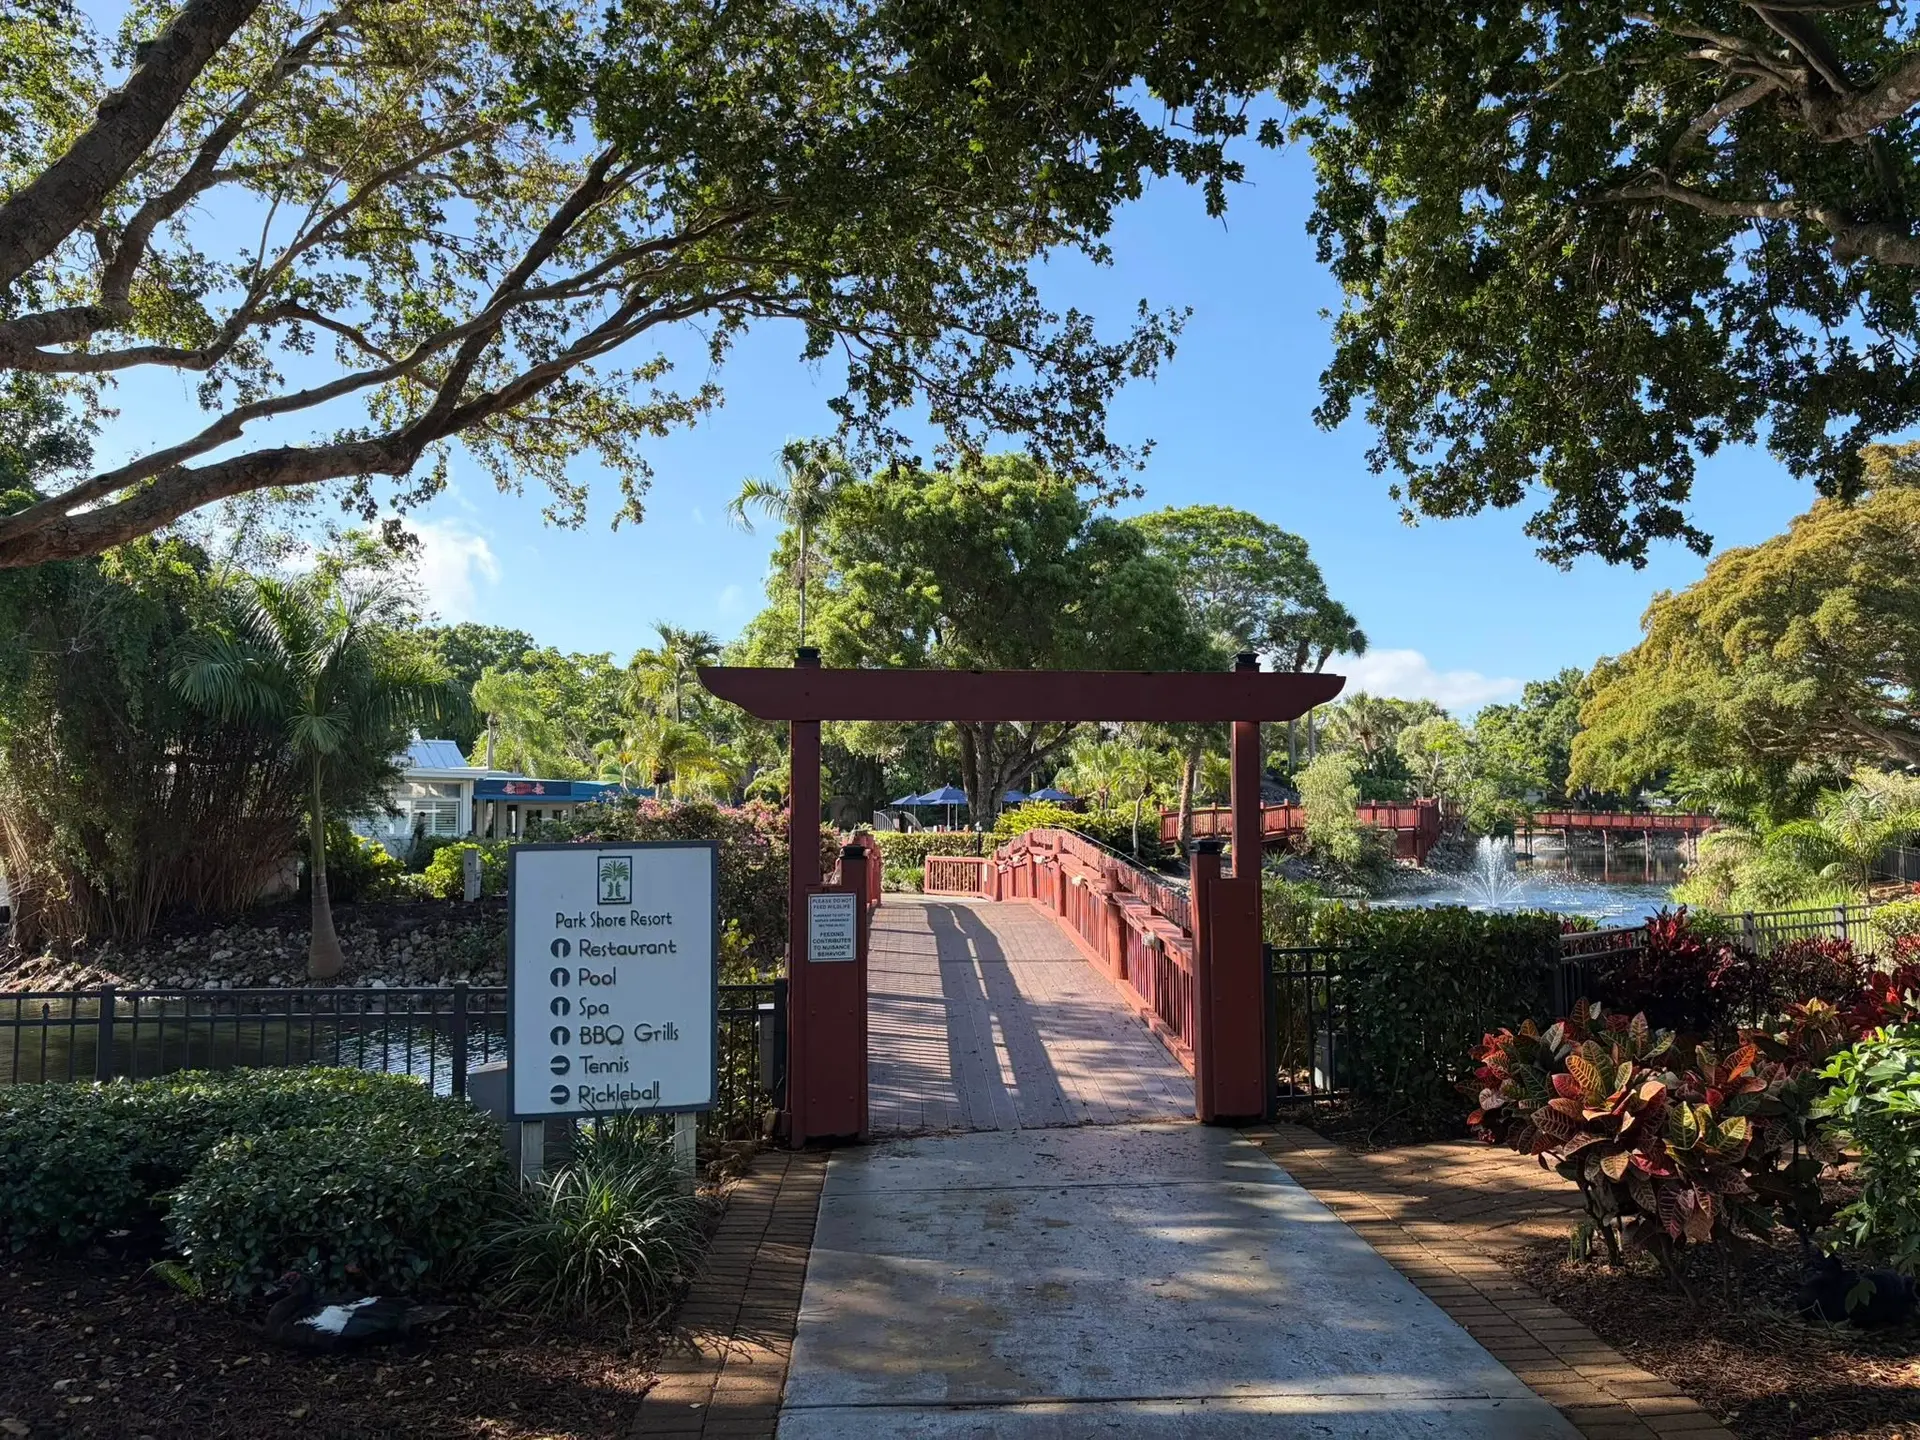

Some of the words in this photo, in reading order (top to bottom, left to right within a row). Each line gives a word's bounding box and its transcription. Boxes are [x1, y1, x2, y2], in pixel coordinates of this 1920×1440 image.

[555, 911, 586, 929] Park
[590, 910, 626, 928] Shore
[630, 910, 673, 926] Resort
[579, 938, 677, 958] Restaurant
[578, 966, 617, 987] Pool
[579, 996, 610, 1019] Spa
[579, 1024, 624, 1045] BBQ
[634, 1021, 679, 1042] Grills
[579, 1055, 630, 1074] Tennis
